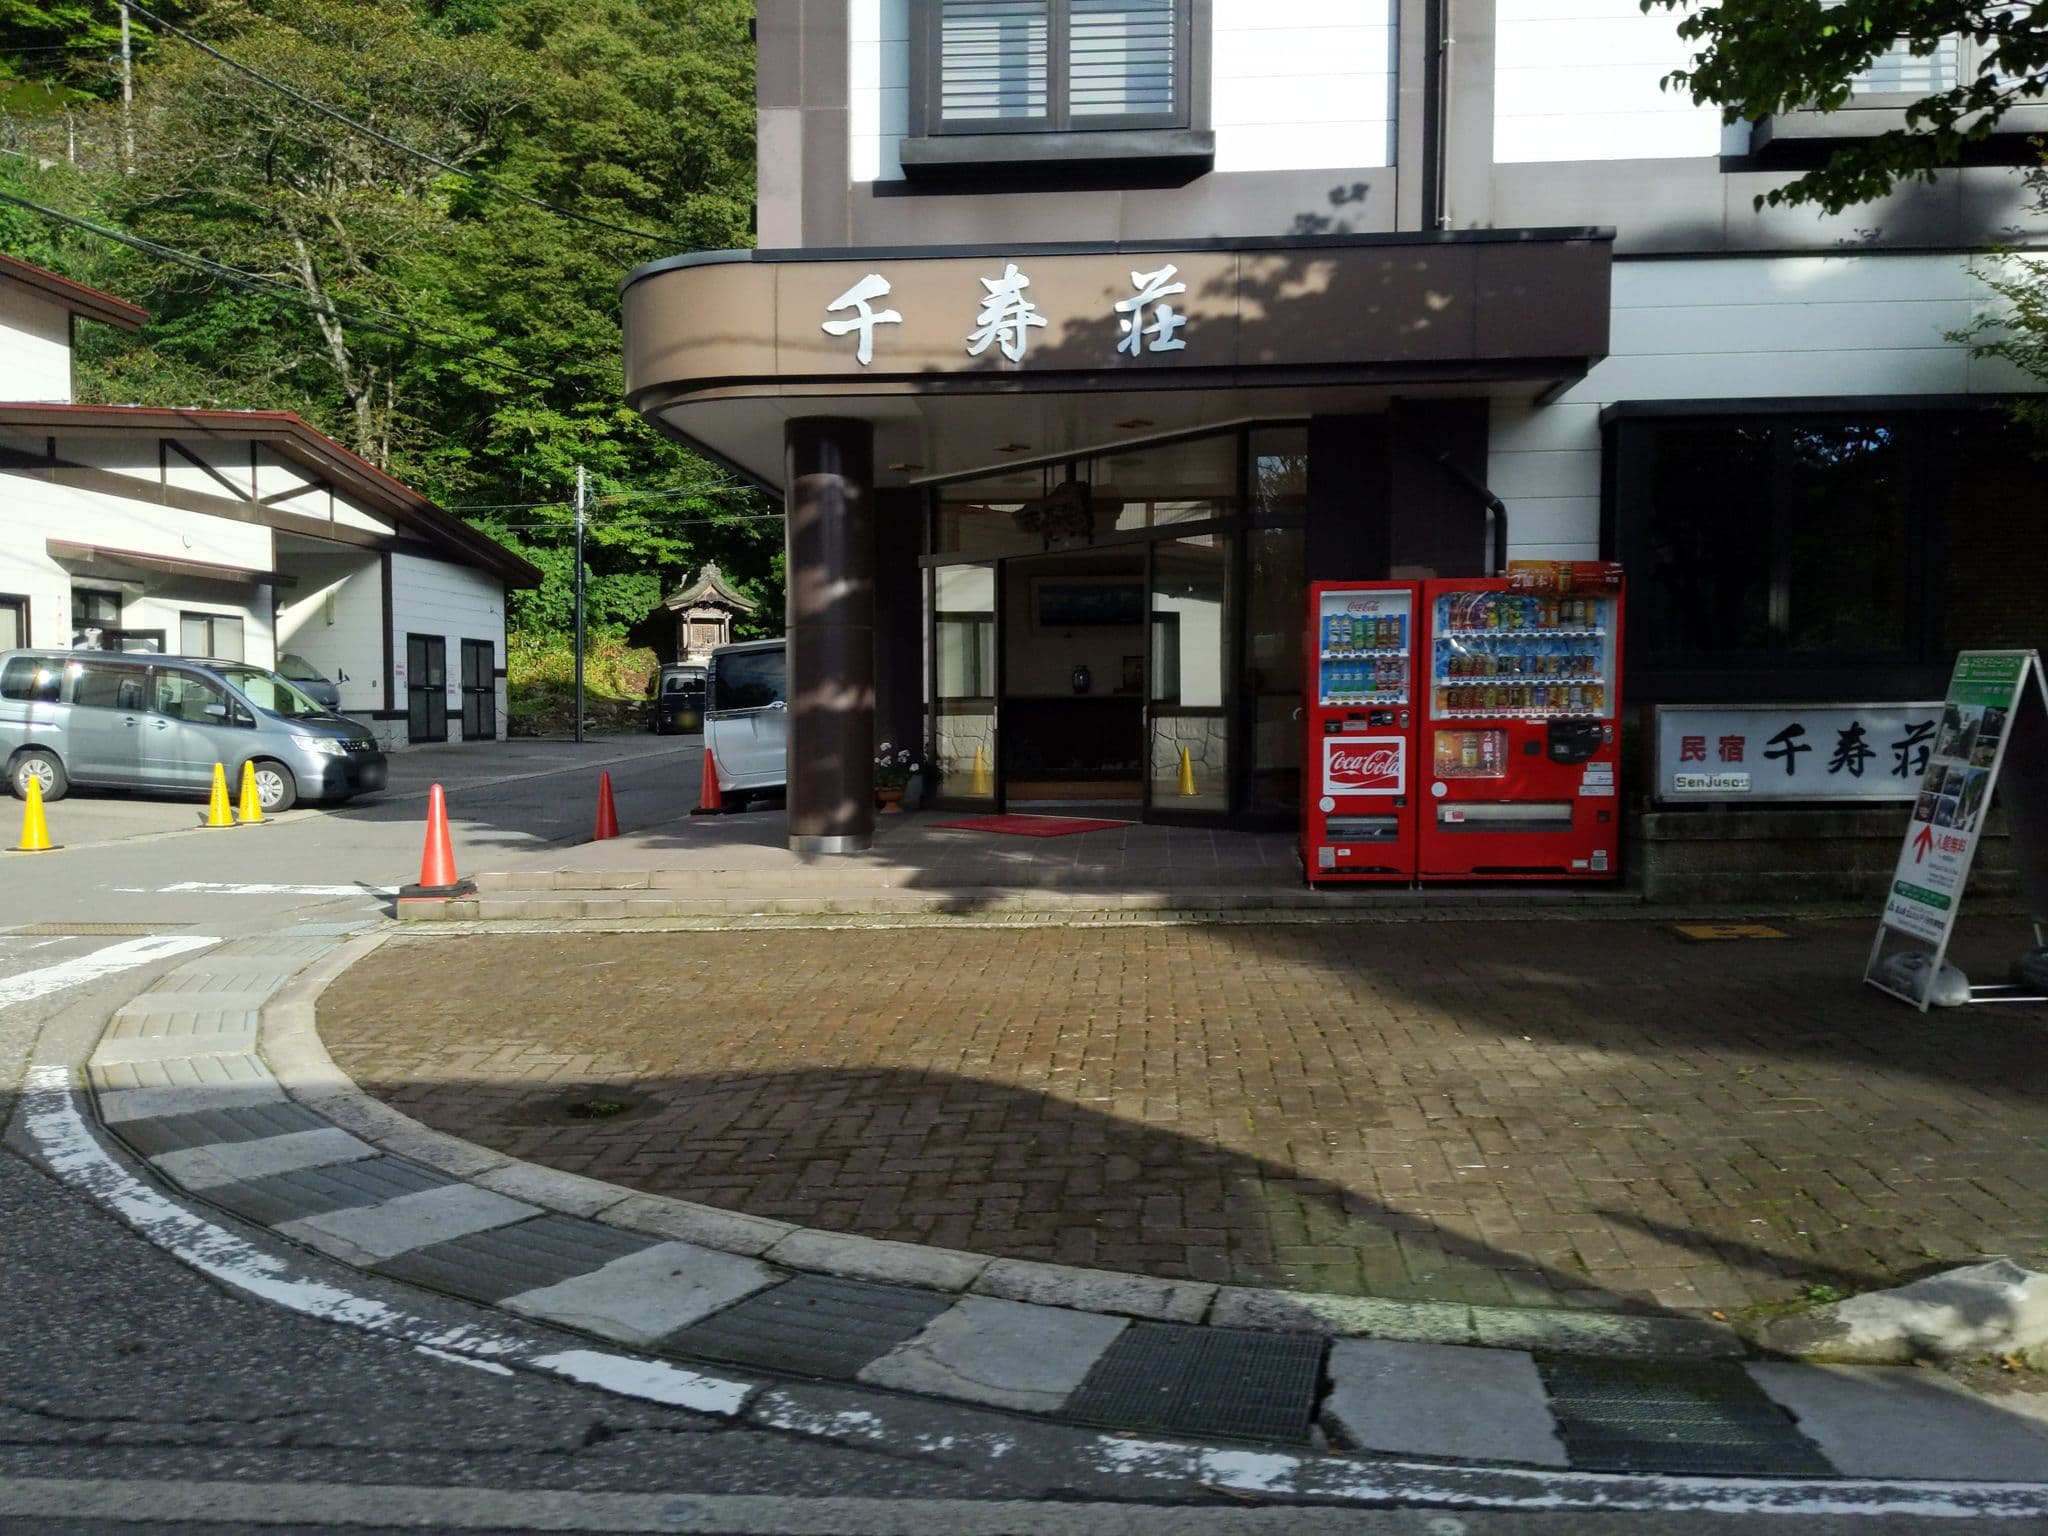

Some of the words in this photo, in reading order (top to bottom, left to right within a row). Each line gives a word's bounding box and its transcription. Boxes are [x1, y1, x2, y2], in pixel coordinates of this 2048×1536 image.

[821, 263, 1187, 366] 千寿荘
[1347, 600, 1380, 612] Coca-Cola
[1330, 749, 1399, 776] Coca-Cola
[1680, 735, 1745, 762] 民宿
[1764, 720, 1936, 778] 千寿荘
